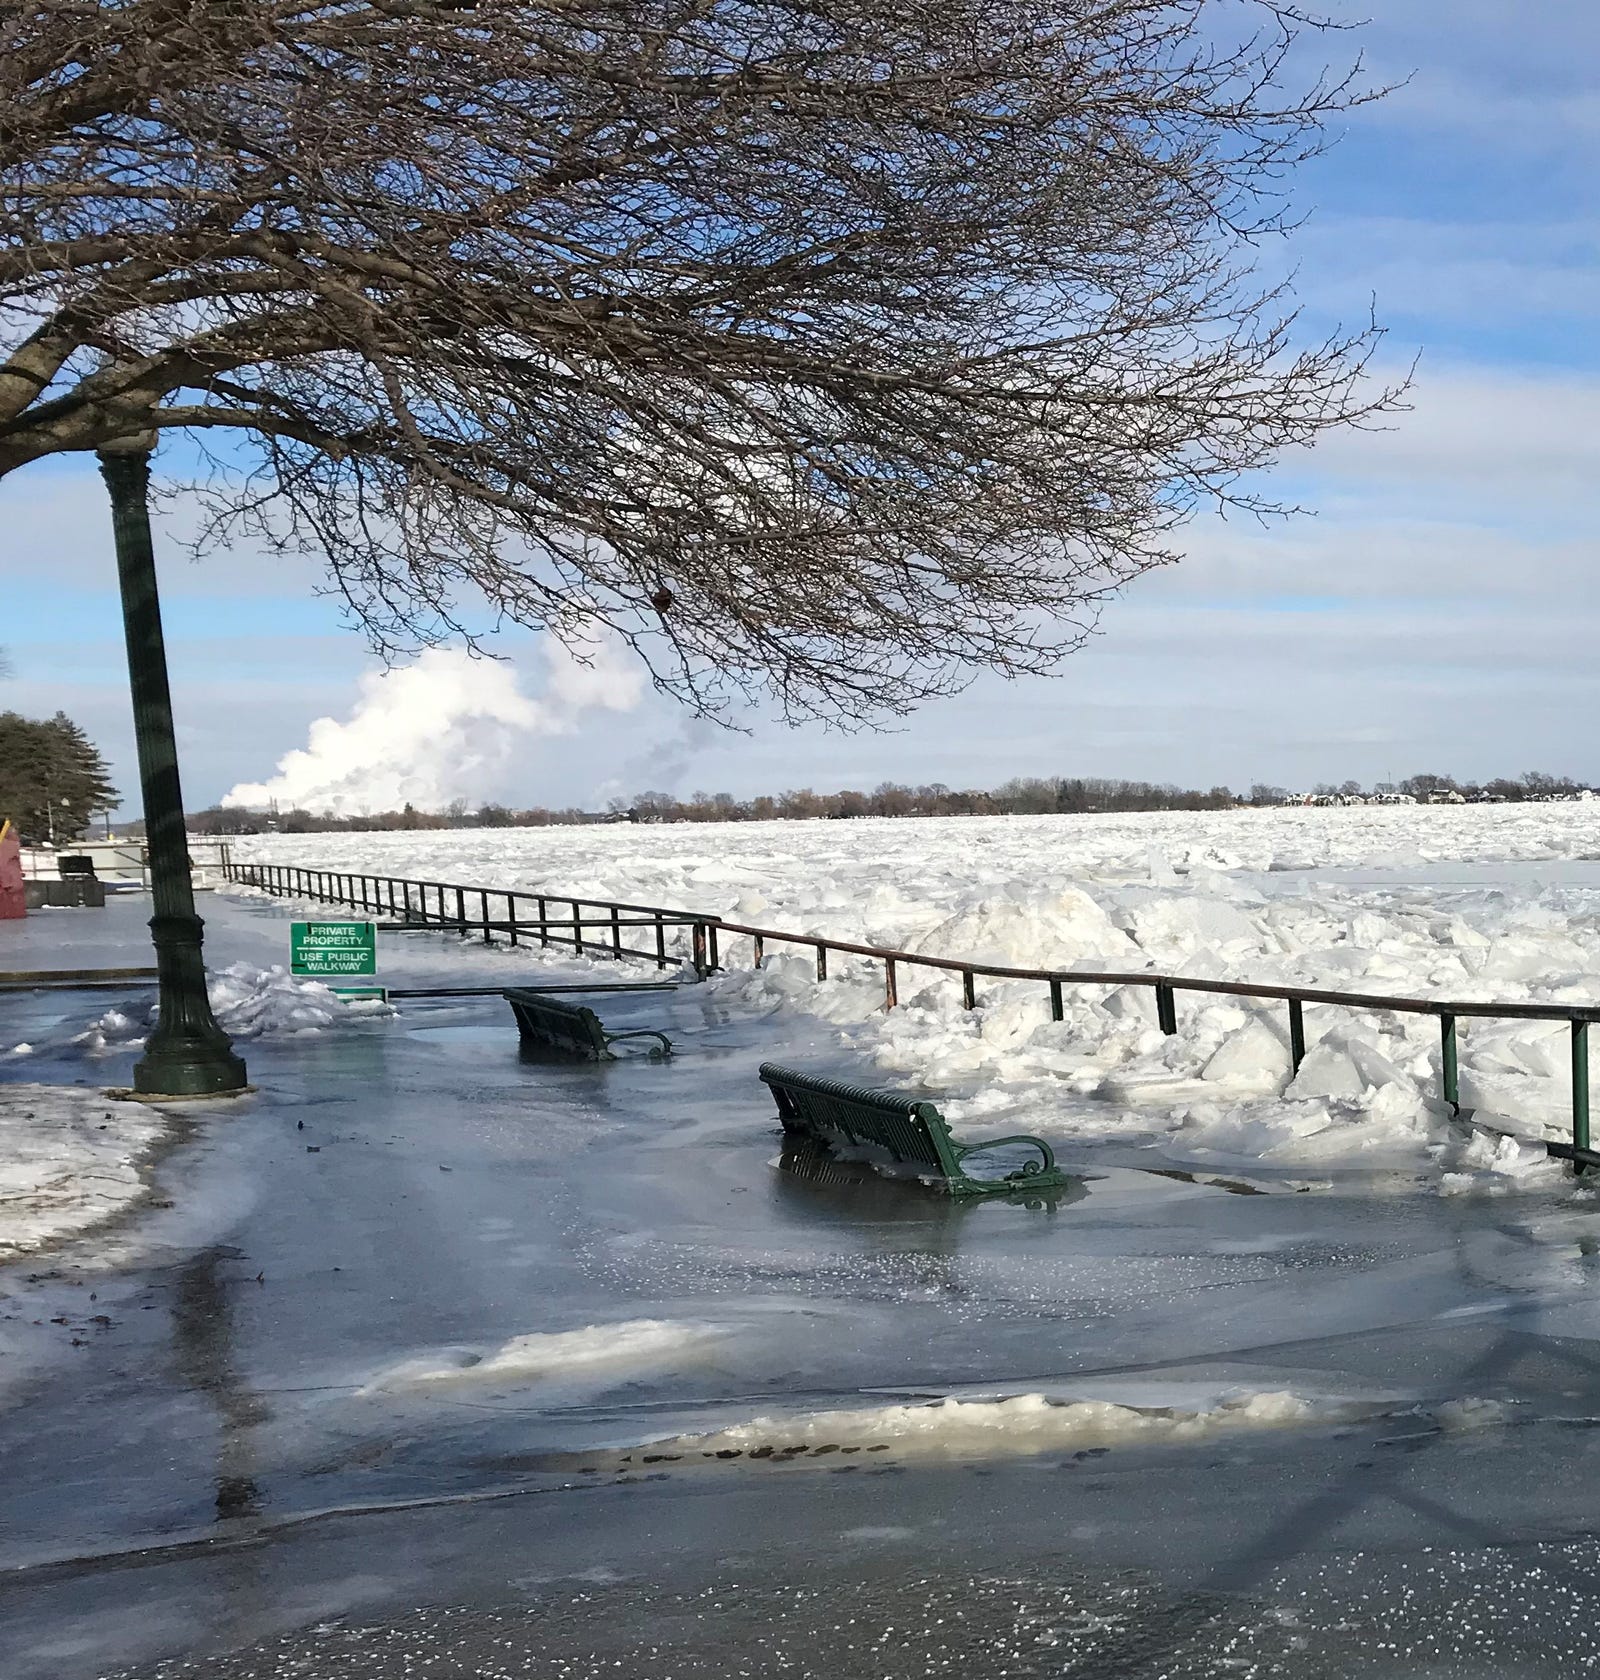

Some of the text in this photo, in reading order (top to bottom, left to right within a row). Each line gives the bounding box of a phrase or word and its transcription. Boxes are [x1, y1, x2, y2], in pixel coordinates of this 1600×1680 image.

[311, 927, 356, 935] PRIVATE
[303, 936, 363, 945] PROPERTY
[299, 952, 368, 961] USE PUBLIC
[307, 962, 361, 971] WALKWAY
